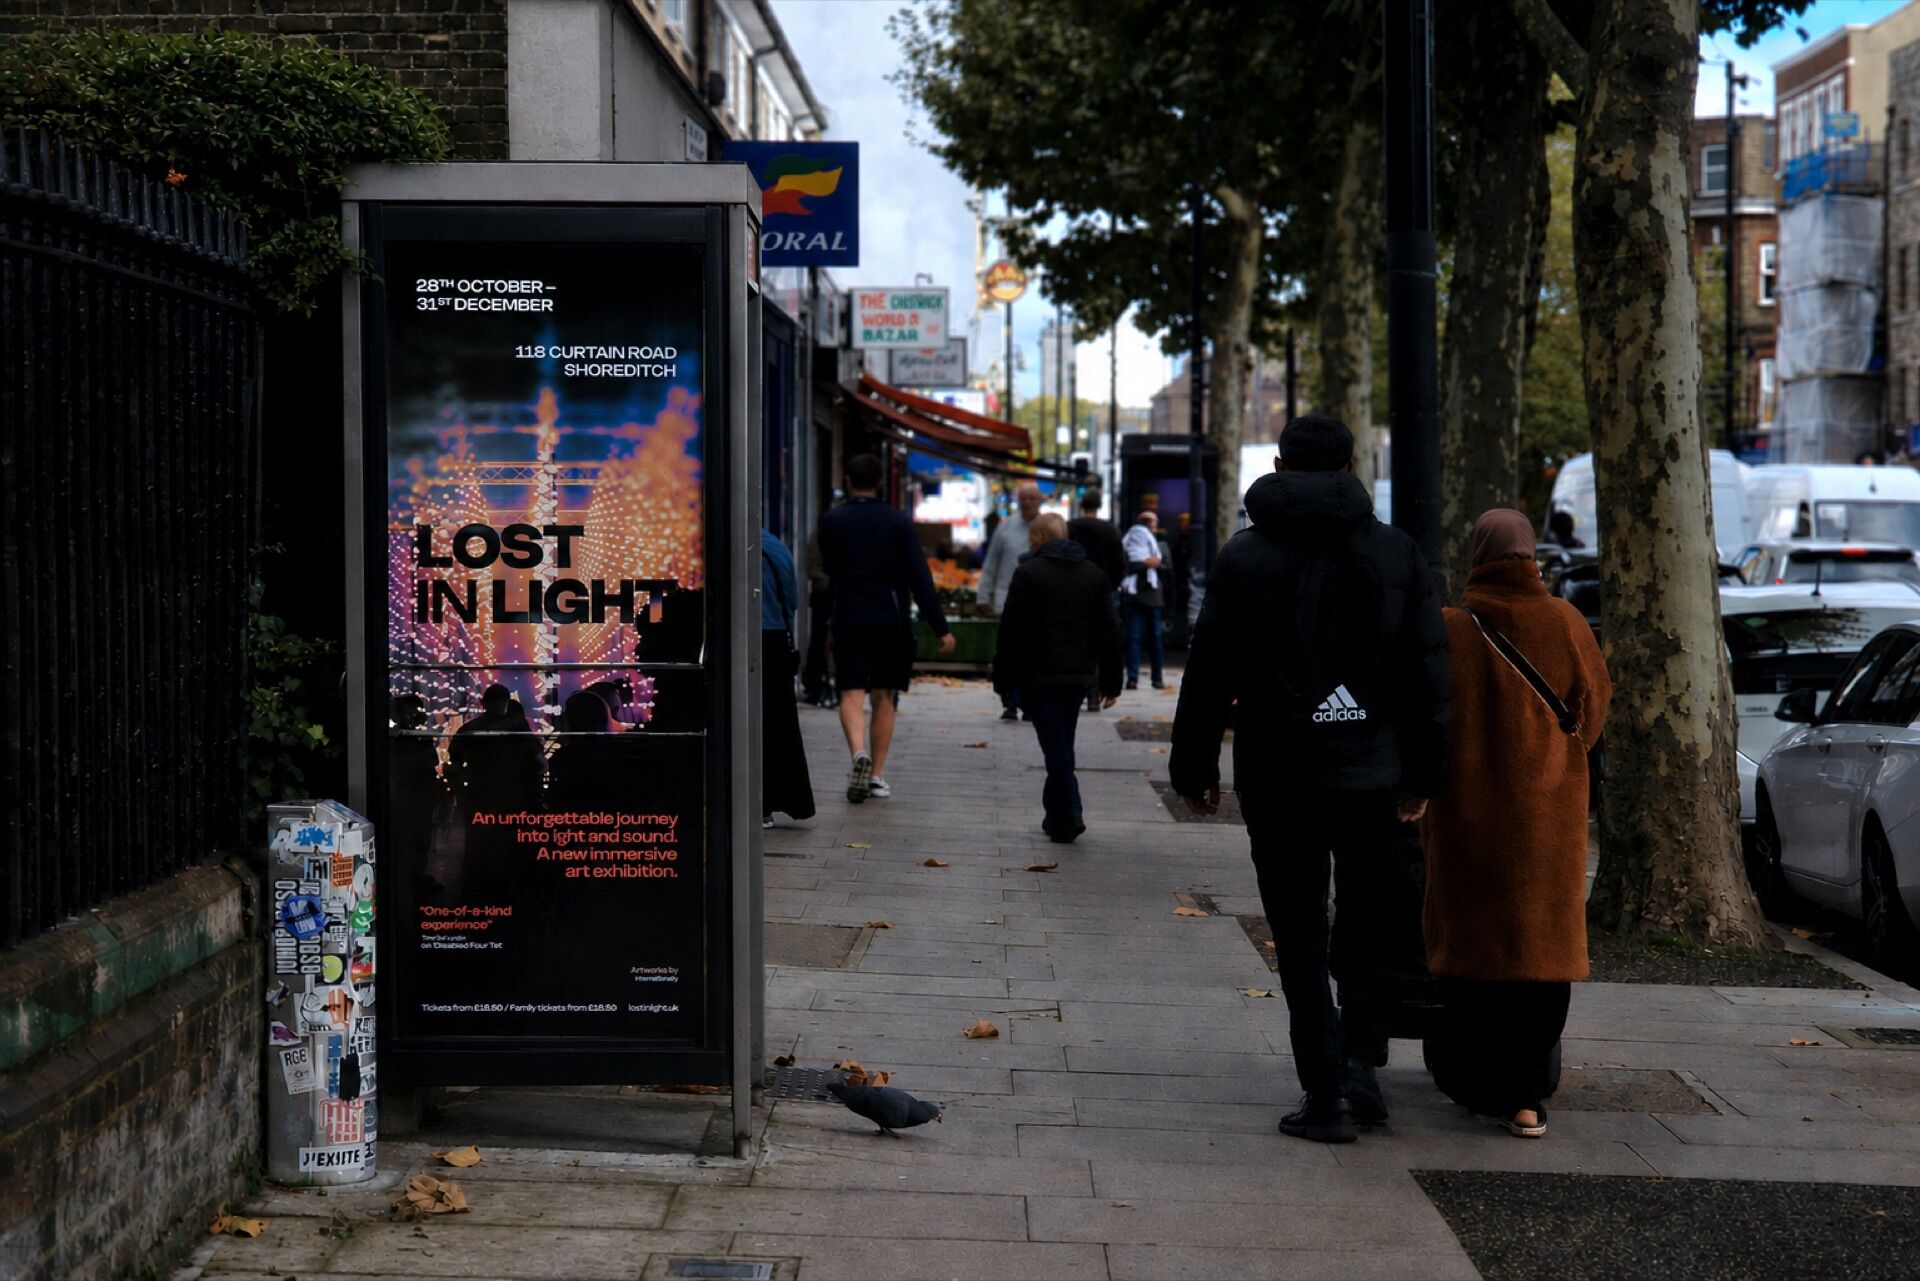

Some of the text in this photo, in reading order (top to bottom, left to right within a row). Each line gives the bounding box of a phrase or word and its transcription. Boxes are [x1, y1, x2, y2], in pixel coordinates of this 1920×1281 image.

[761, 231, 847, 251] ORAL
[416, 279, 454, 293] 28TH
[457, 279, 543, 294] OCTOBER
[416, 298, 554, 312] 31ST DECEMBER
[859, 292, 886, 310] THE
[862, 313, 906, 326] WORLD
[515, 346, 677, 360] 118 CURTAIN ROAD
[564, 364, 677, 378] SHOREDITCH
[416, 523, 585, 569] LOST
[417, 578, 680, 624] IN LIGHT
[1312, 708, 1367, 723] adidas
[472, 811, 679, 828] An unforgettable journey
[517, 829, 550, 843] into
[588, 829, 620, 843] and
[623, 829, 679, 843] sound.
[537, 847, 678, 861] A new immersive
[565, 865, 679, 878] art exhibition.
[421, 1003, 452, 1012] Tickets
[452, 1003, 474, 1012] from
[510, 1003, 536, 1013] Family
[537, 1003, 566, 1012] tickets
[567, 1003, 588, 1012] from
